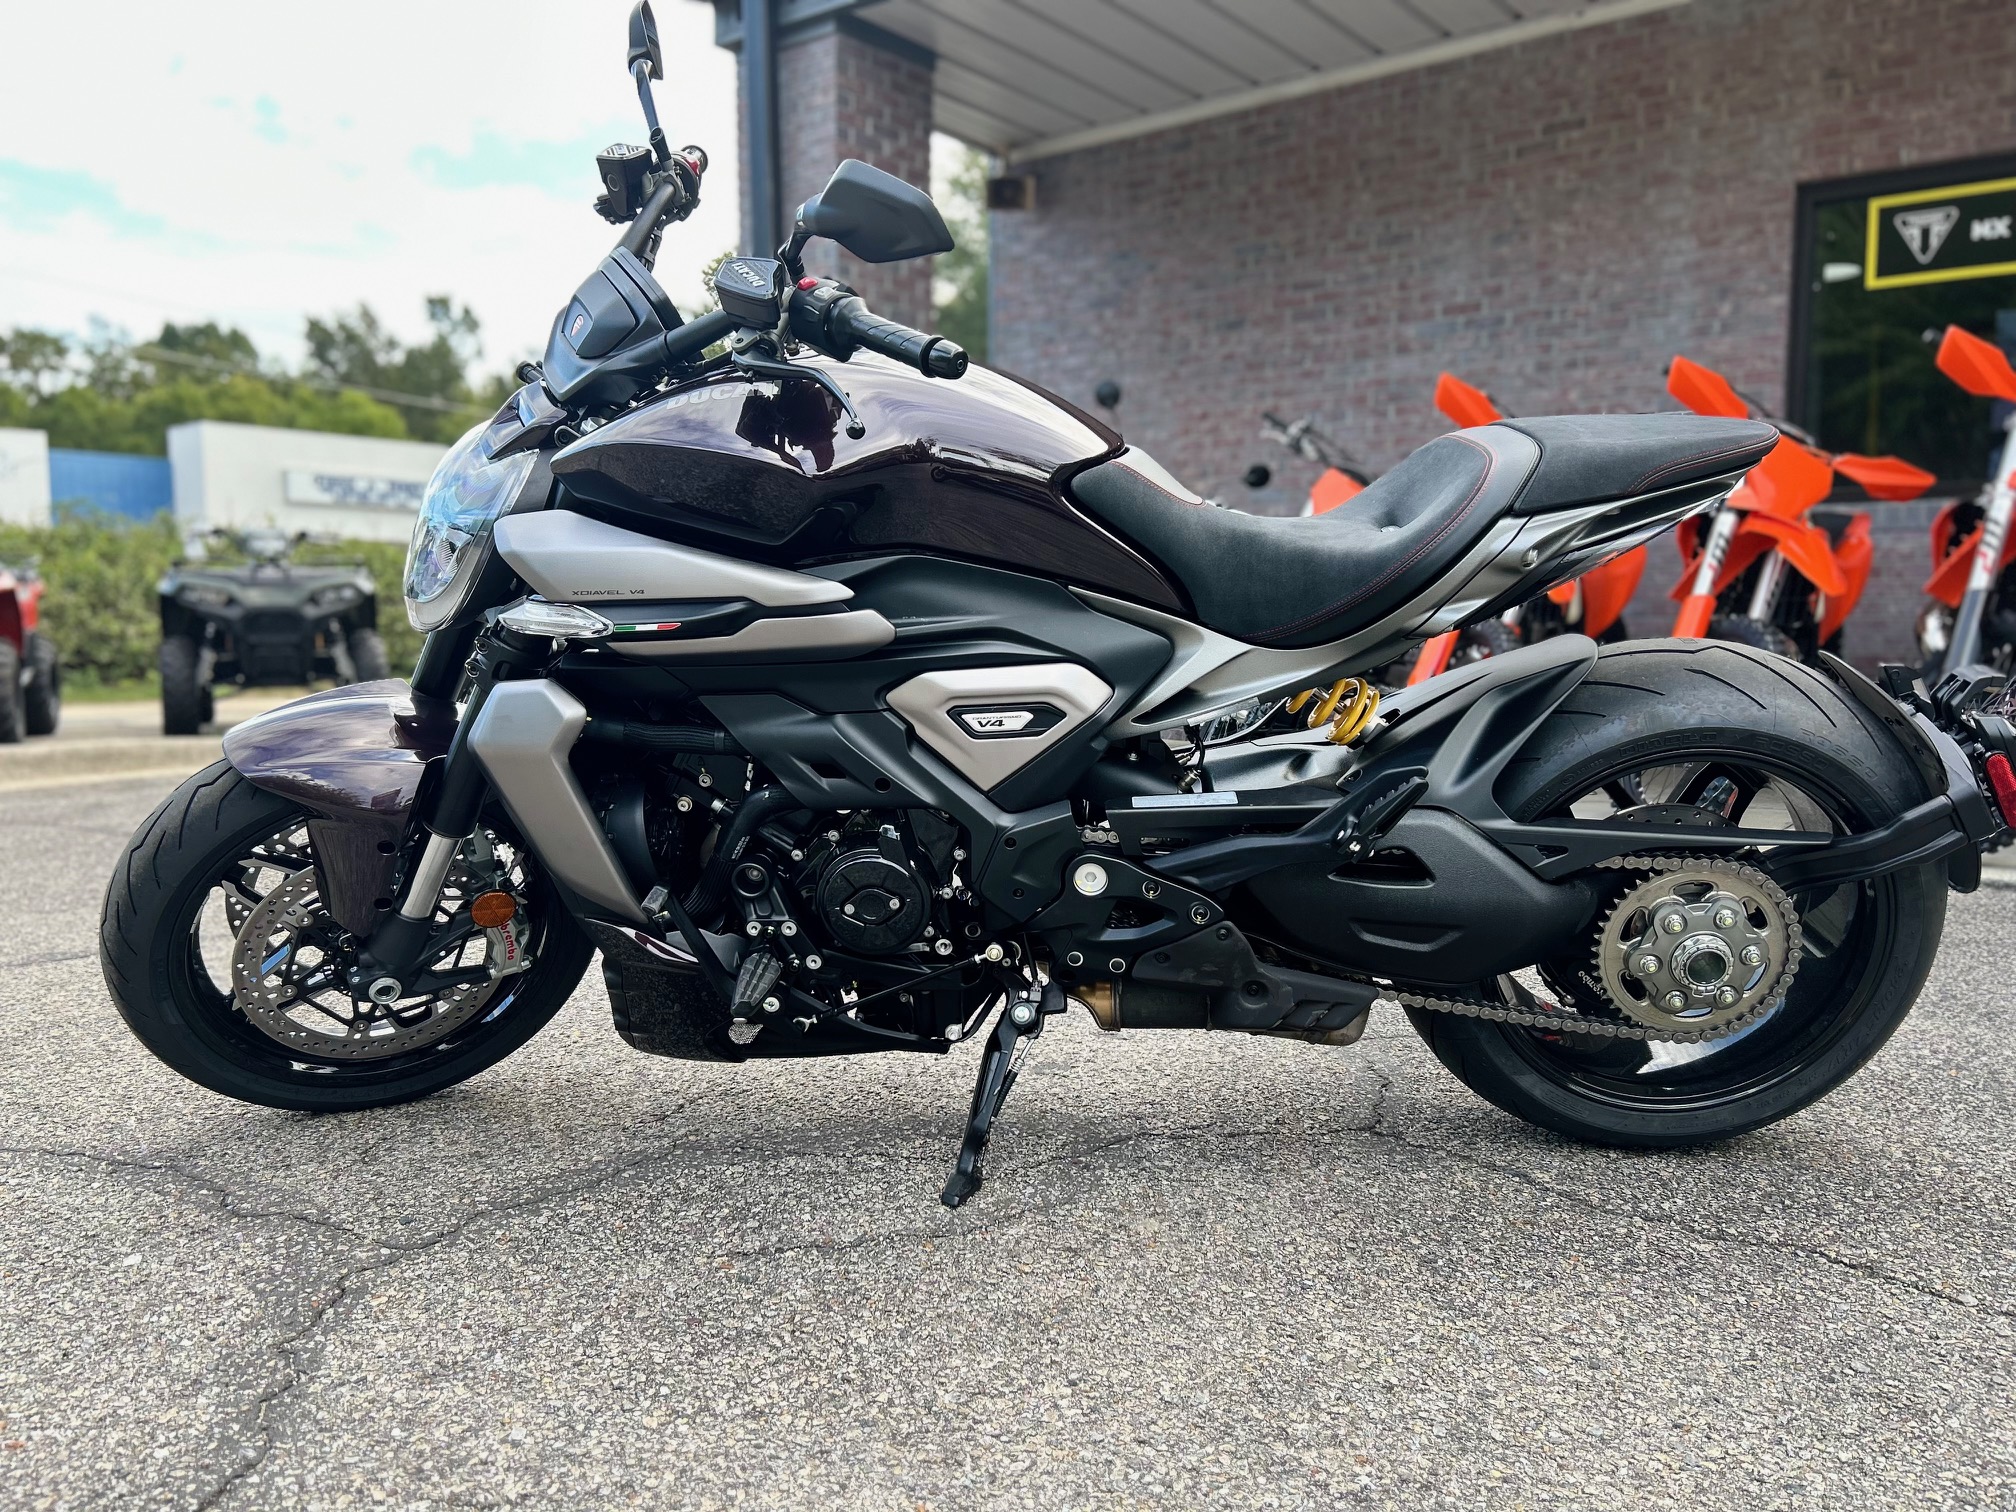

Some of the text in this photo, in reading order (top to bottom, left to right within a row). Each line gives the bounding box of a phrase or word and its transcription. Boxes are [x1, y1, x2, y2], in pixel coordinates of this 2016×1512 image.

[730, 261, 767, 288] DUCATI
[976, 719, 1006, 728] V4
[500, 922, 517, 960] brembo
